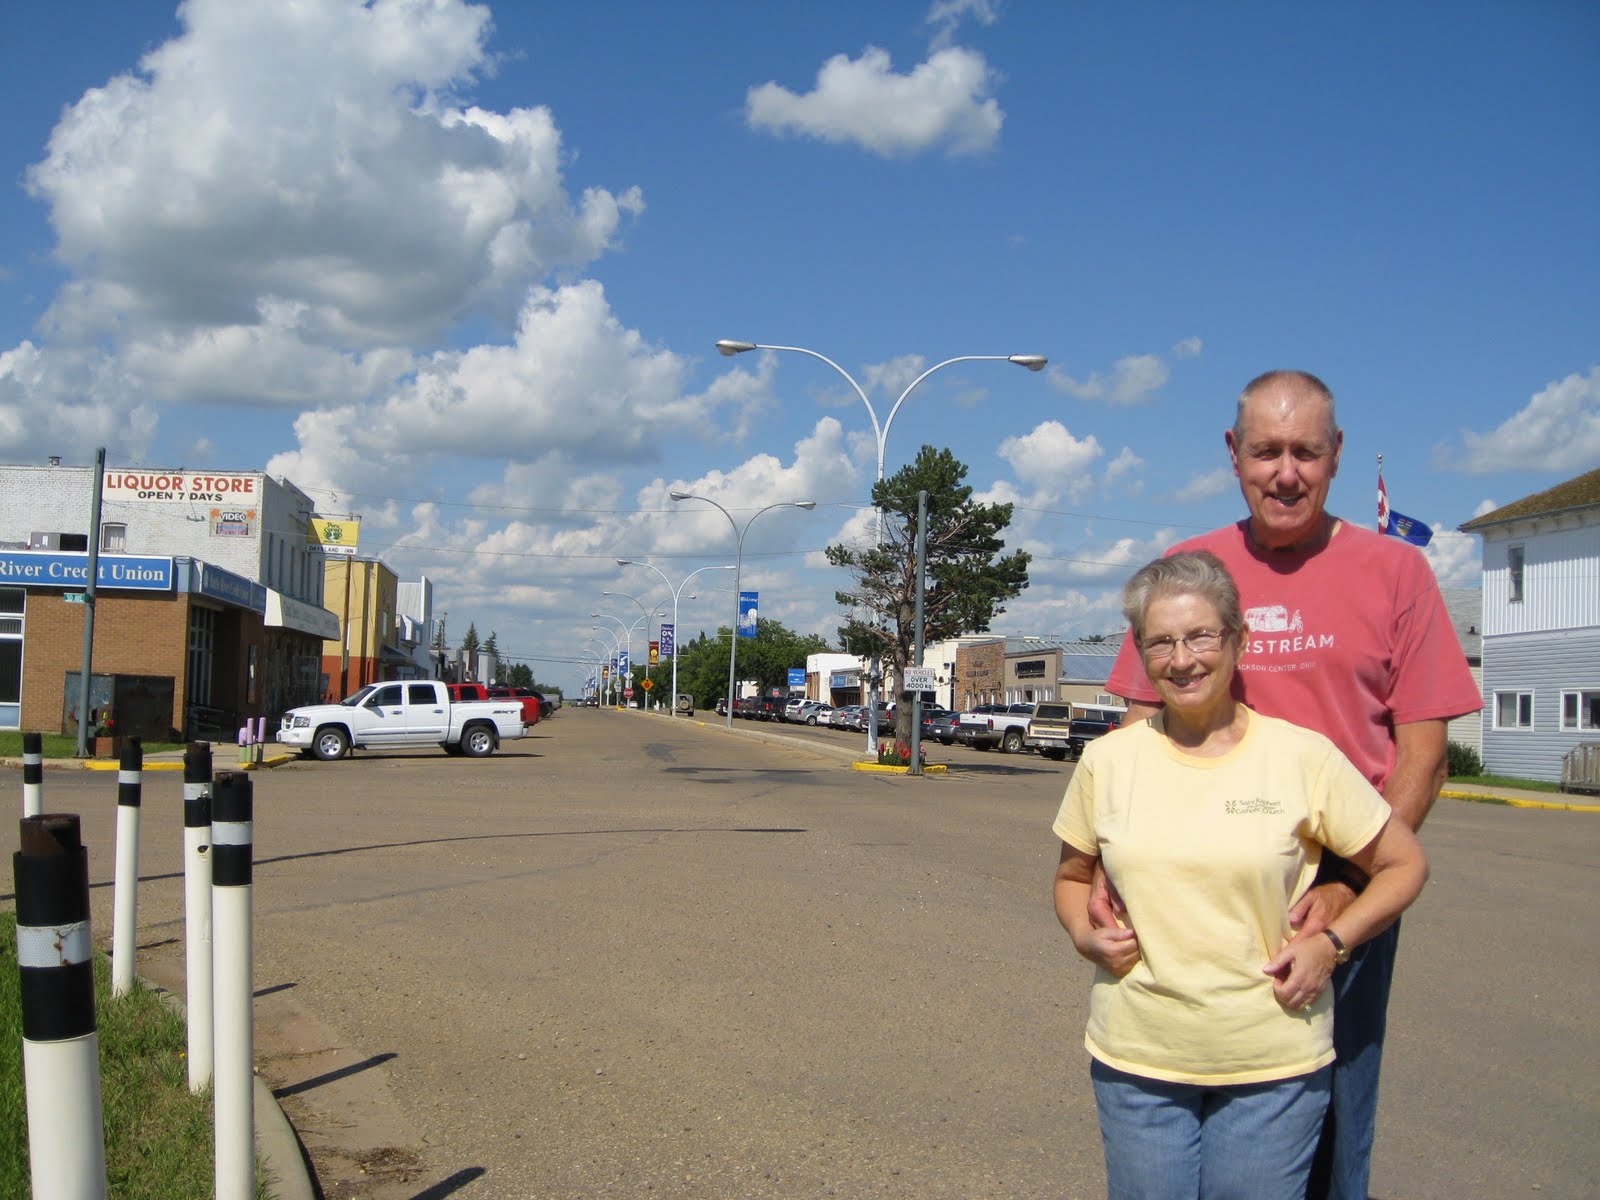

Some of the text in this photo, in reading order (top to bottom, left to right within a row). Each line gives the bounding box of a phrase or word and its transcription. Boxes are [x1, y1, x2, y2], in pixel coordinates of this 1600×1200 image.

[107, 474, 254, 493] LIQUOR STORE
[138, 491, 223, 502] OPEN 7 DAYS
[219, 511, 247, 523] VIDEO
[0, 560, 165, 581] River Cret Union
[1245, 634, 1335, 654] STREAM
[1269, 664, 1297, 672] CENTER
